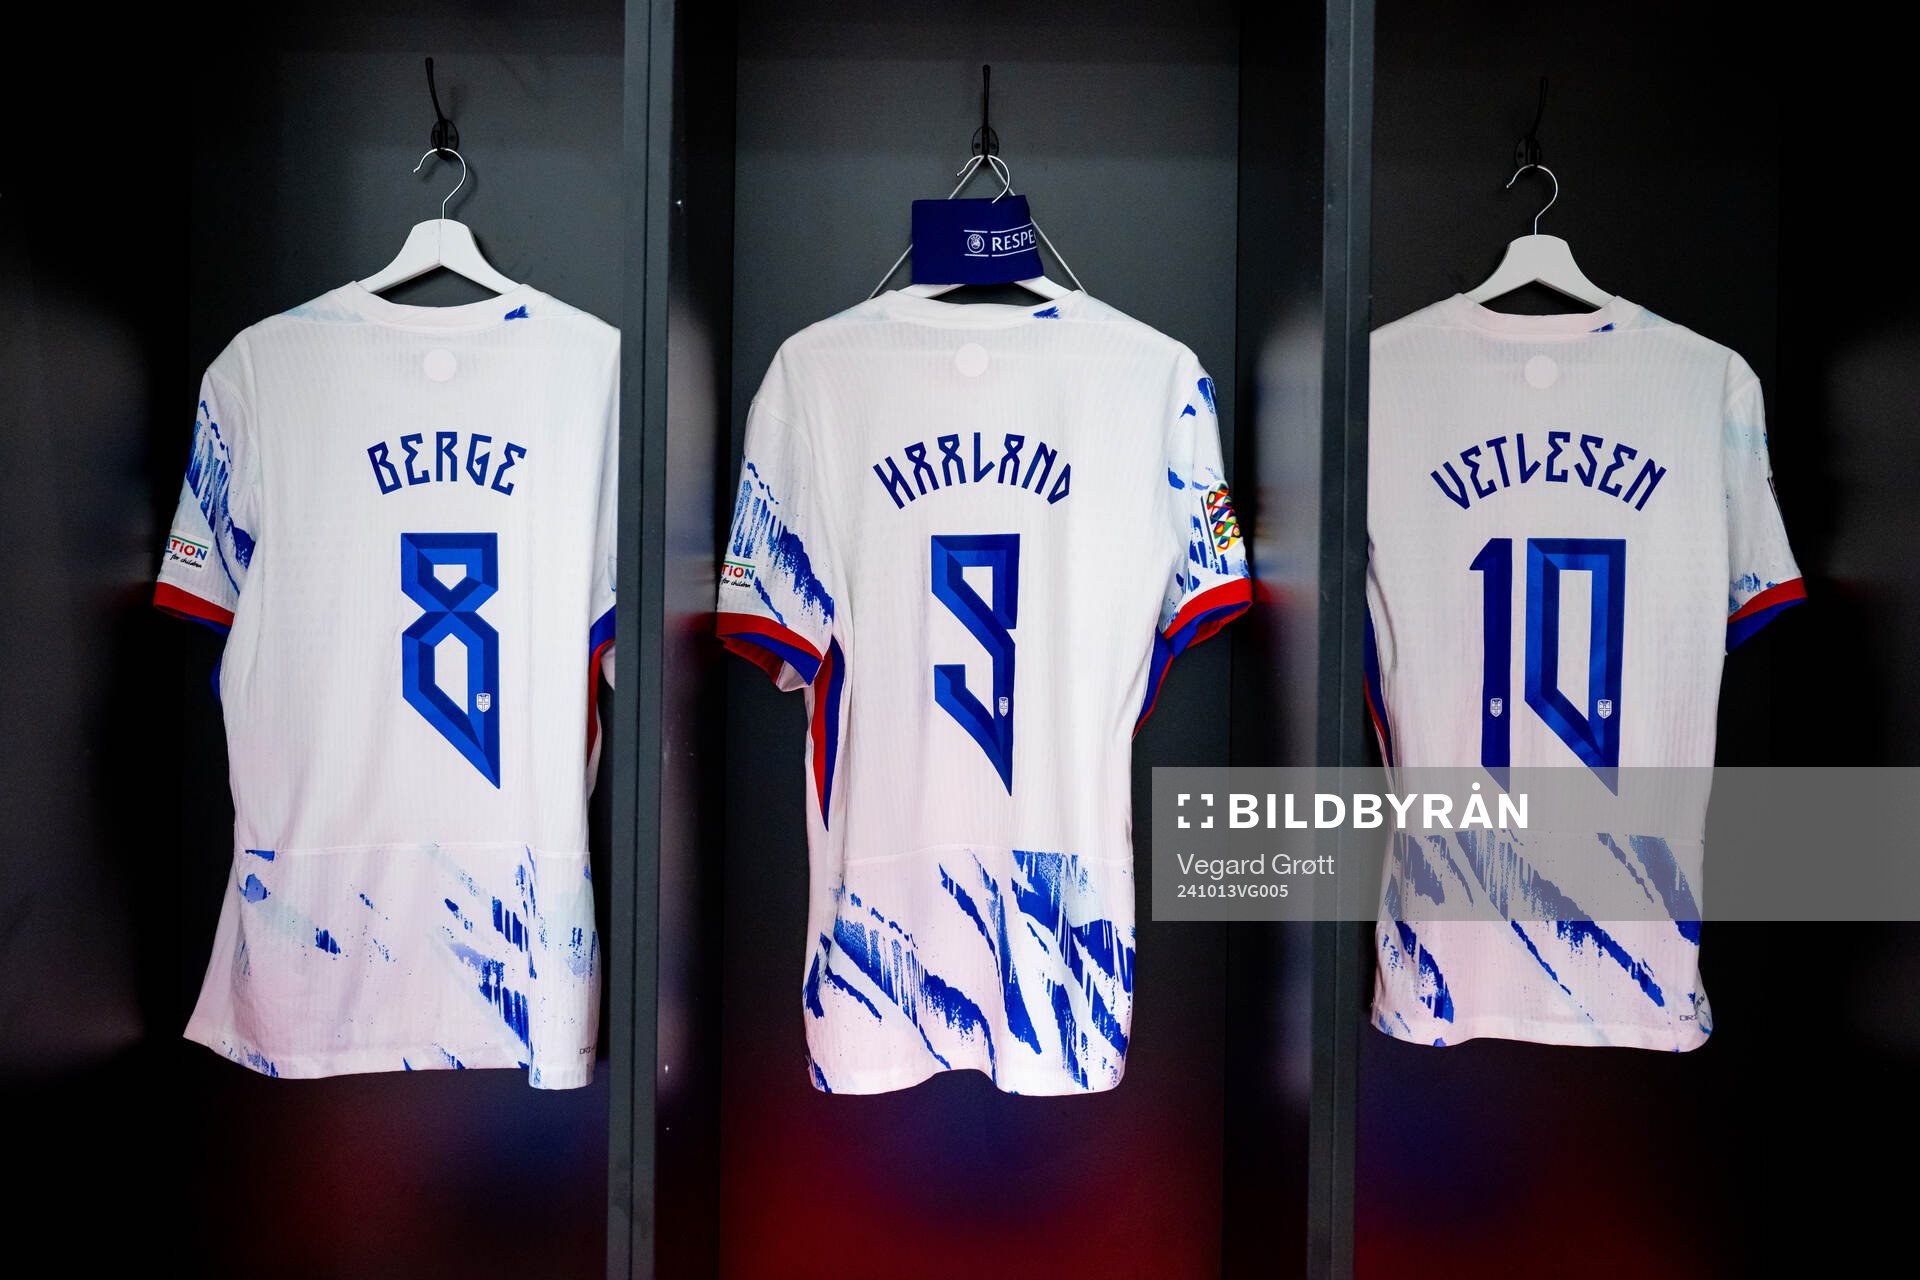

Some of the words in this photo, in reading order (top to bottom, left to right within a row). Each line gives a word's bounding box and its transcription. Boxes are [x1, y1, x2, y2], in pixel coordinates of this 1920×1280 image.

[991, 229, 1037, 252] RESPE
[367, 431, 527, 496] BERGE
[874, 431, 1071, 509] HAALAND
[1431, 431, 1667, 512] VETLESEN
[401, 532, 499, 789] 8
[931, 533, 1020, 795] 9
[1470, 537, 1627, 796] 10
